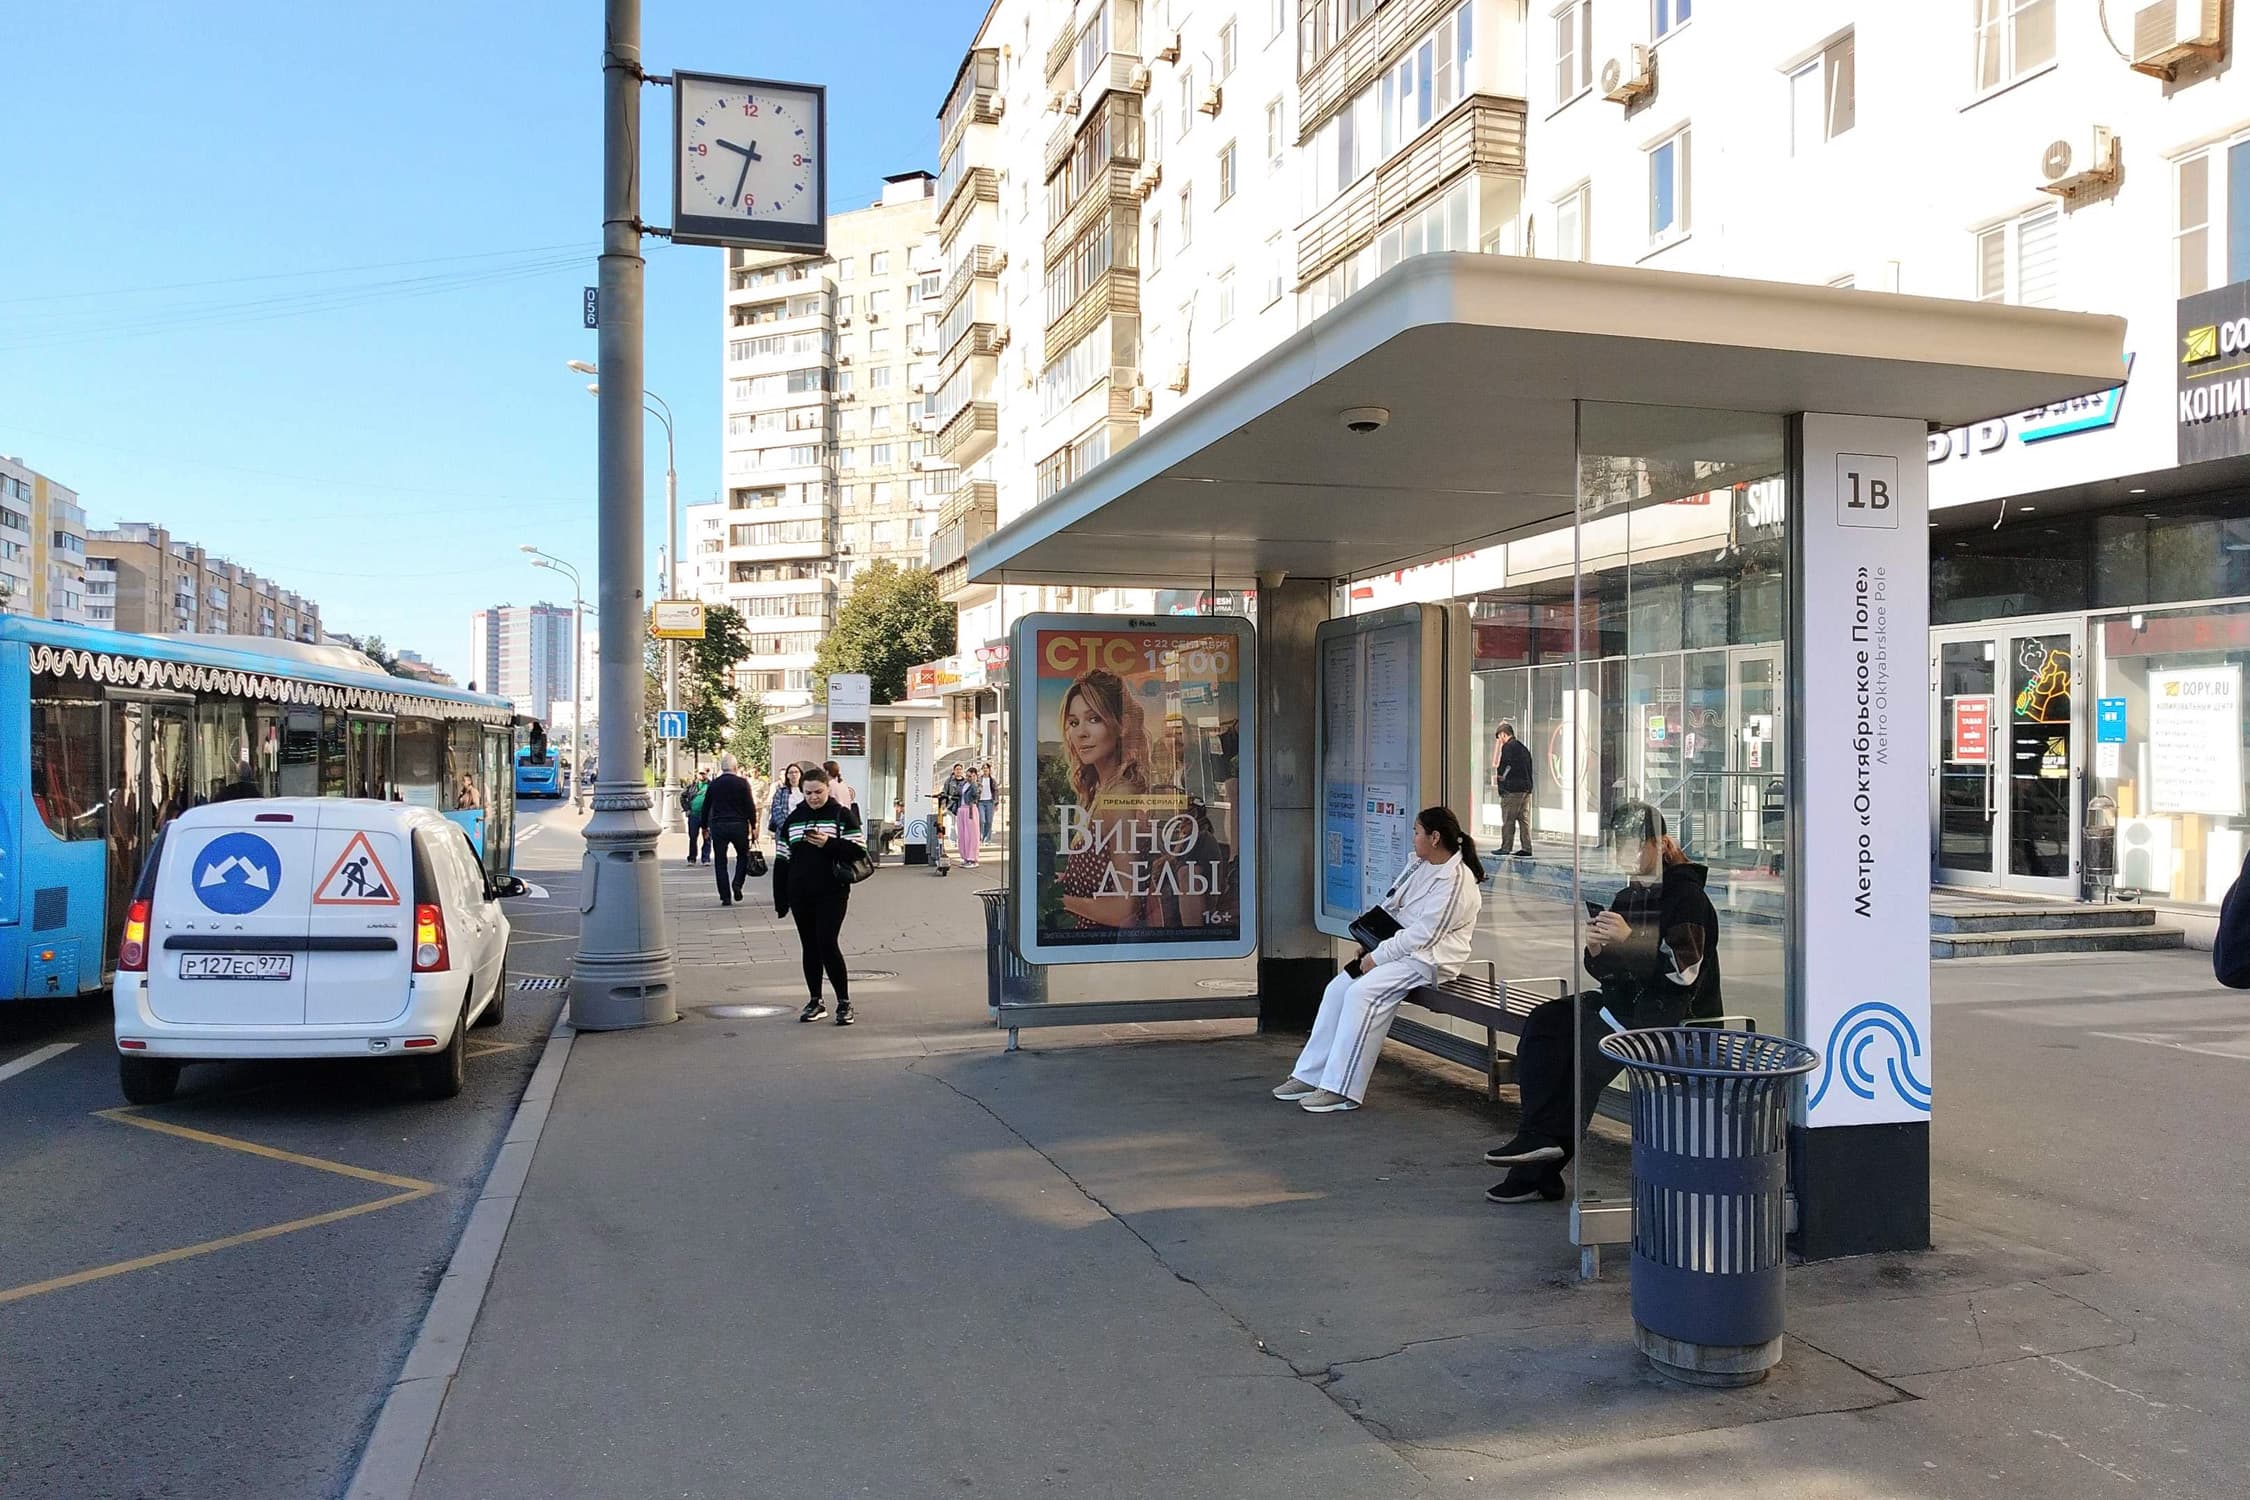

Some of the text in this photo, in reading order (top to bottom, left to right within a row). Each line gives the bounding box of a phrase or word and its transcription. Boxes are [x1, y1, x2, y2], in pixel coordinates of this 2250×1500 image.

[743, 105, 758, 117] 12
[697, 144, 708, 156] 9
[793, 154, 802, 166] 3
[744, 194, 755, 206] 6
[587, 290, 596, 324] 056
[1143, 640, 1151, 648] С
[1155, 640, 1168, 648] 22
[1046, 636, 1136, 673] СТС
[1873, 566, 1889, 765] Metro Oktyabrskoe Pole
[2183, 681, 2229, 696] COPY.RU
[1852, 566, 1875, 918] Метро «Октябрьское Поле»
[1103, 798, 1184, 806] ПРЕМЬЕРА СЕРИАЛА
[1202, 910, 1232, 925] 16+
[259, 957, 286, 970] 977
